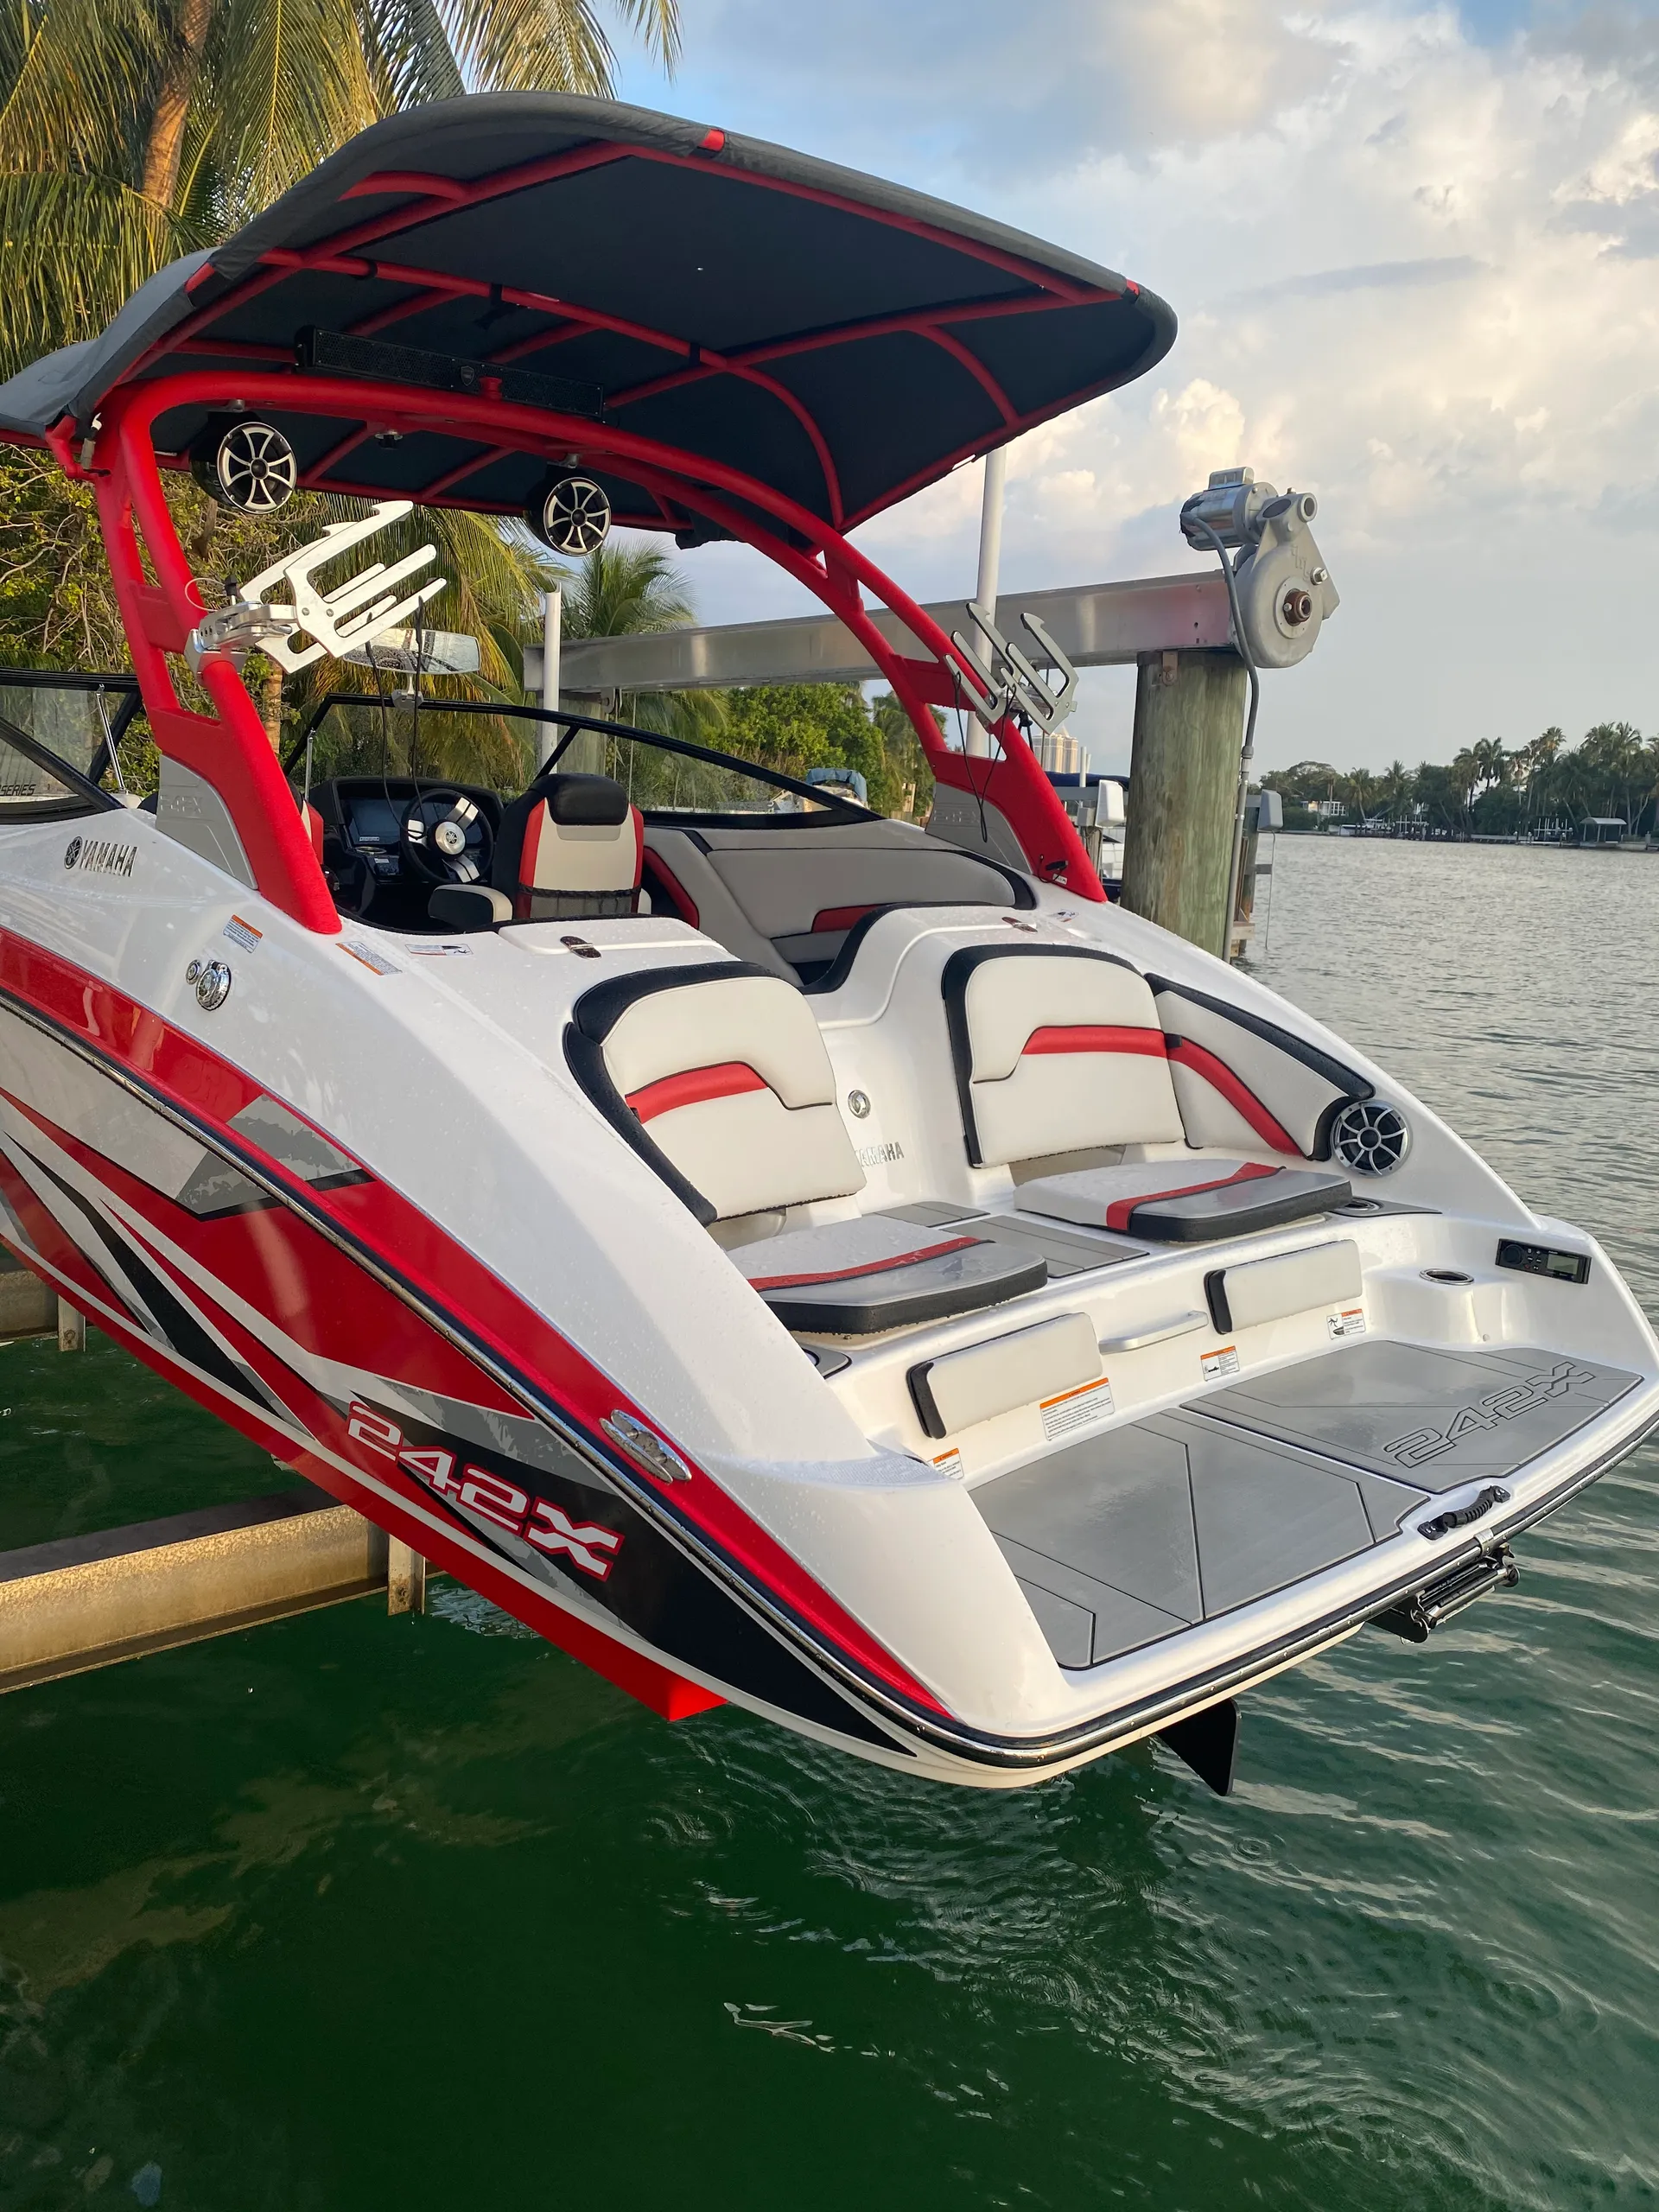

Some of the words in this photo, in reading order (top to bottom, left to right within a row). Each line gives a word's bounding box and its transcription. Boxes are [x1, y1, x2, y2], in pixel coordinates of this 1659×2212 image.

[79, 840, 138, 877] YAMAHA
[855, 1141, 905, 1168] AMAHA
[1383, 1362, 1596, 1468] 242X
[346, 1402, 625, 1581] 242X
